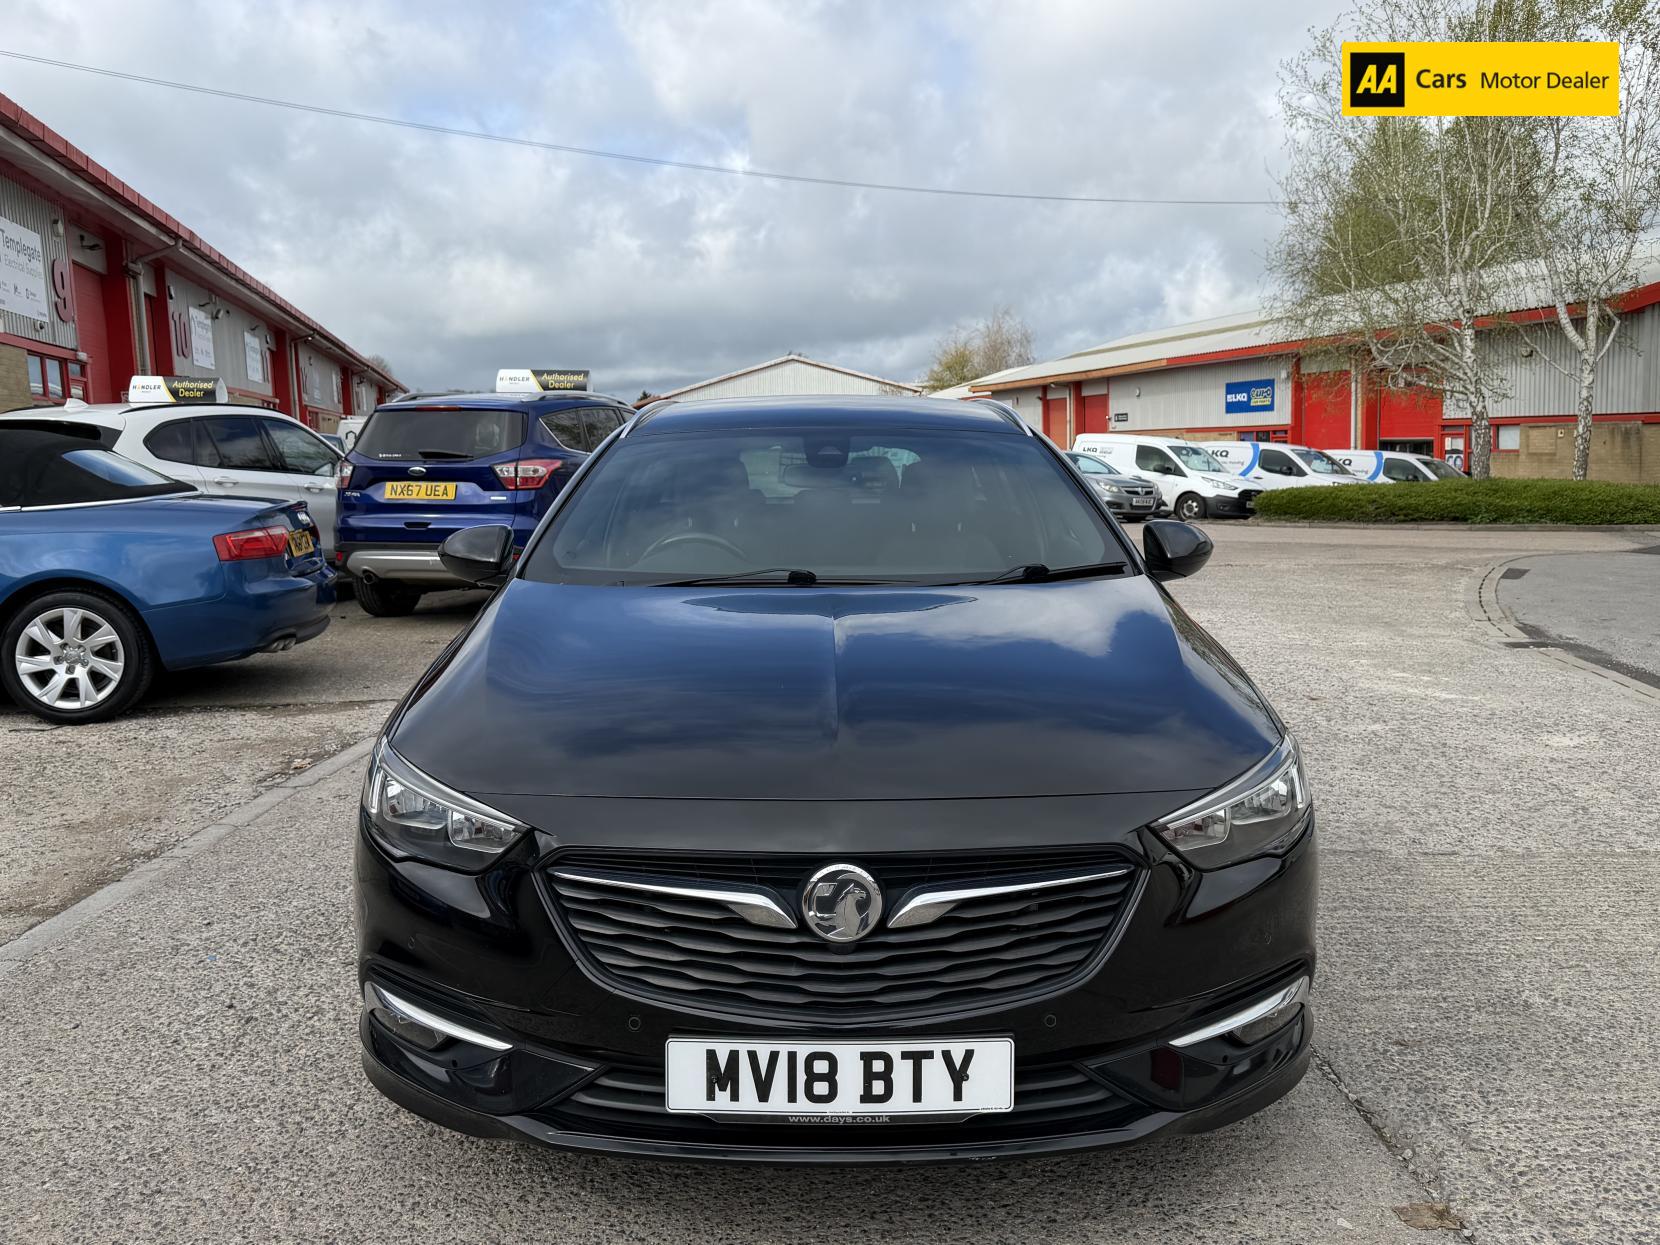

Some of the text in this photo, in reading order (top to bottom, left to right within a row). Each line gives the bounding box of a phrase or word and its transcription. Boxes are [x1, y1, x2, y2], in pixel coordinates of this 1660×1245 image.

[0, 228, 41, 263] Templegate
[52, 258, 74, 323] 9
[172, 311, 190, 359] 10
[541, 372, 585, 381] Authorised
[172, 380, 214, 389] Authorised
[548, 380, 575, 389] Dealer
[178, 388, 204, 397] Dealer
[1210, 449, 1230, 458] KQ
[390, 484, 449, 498] NX67 UEA
[705, 1048, 975, 1104] MV18 BTY
[788, 1113, 891, 1125] www.days.co.uk
